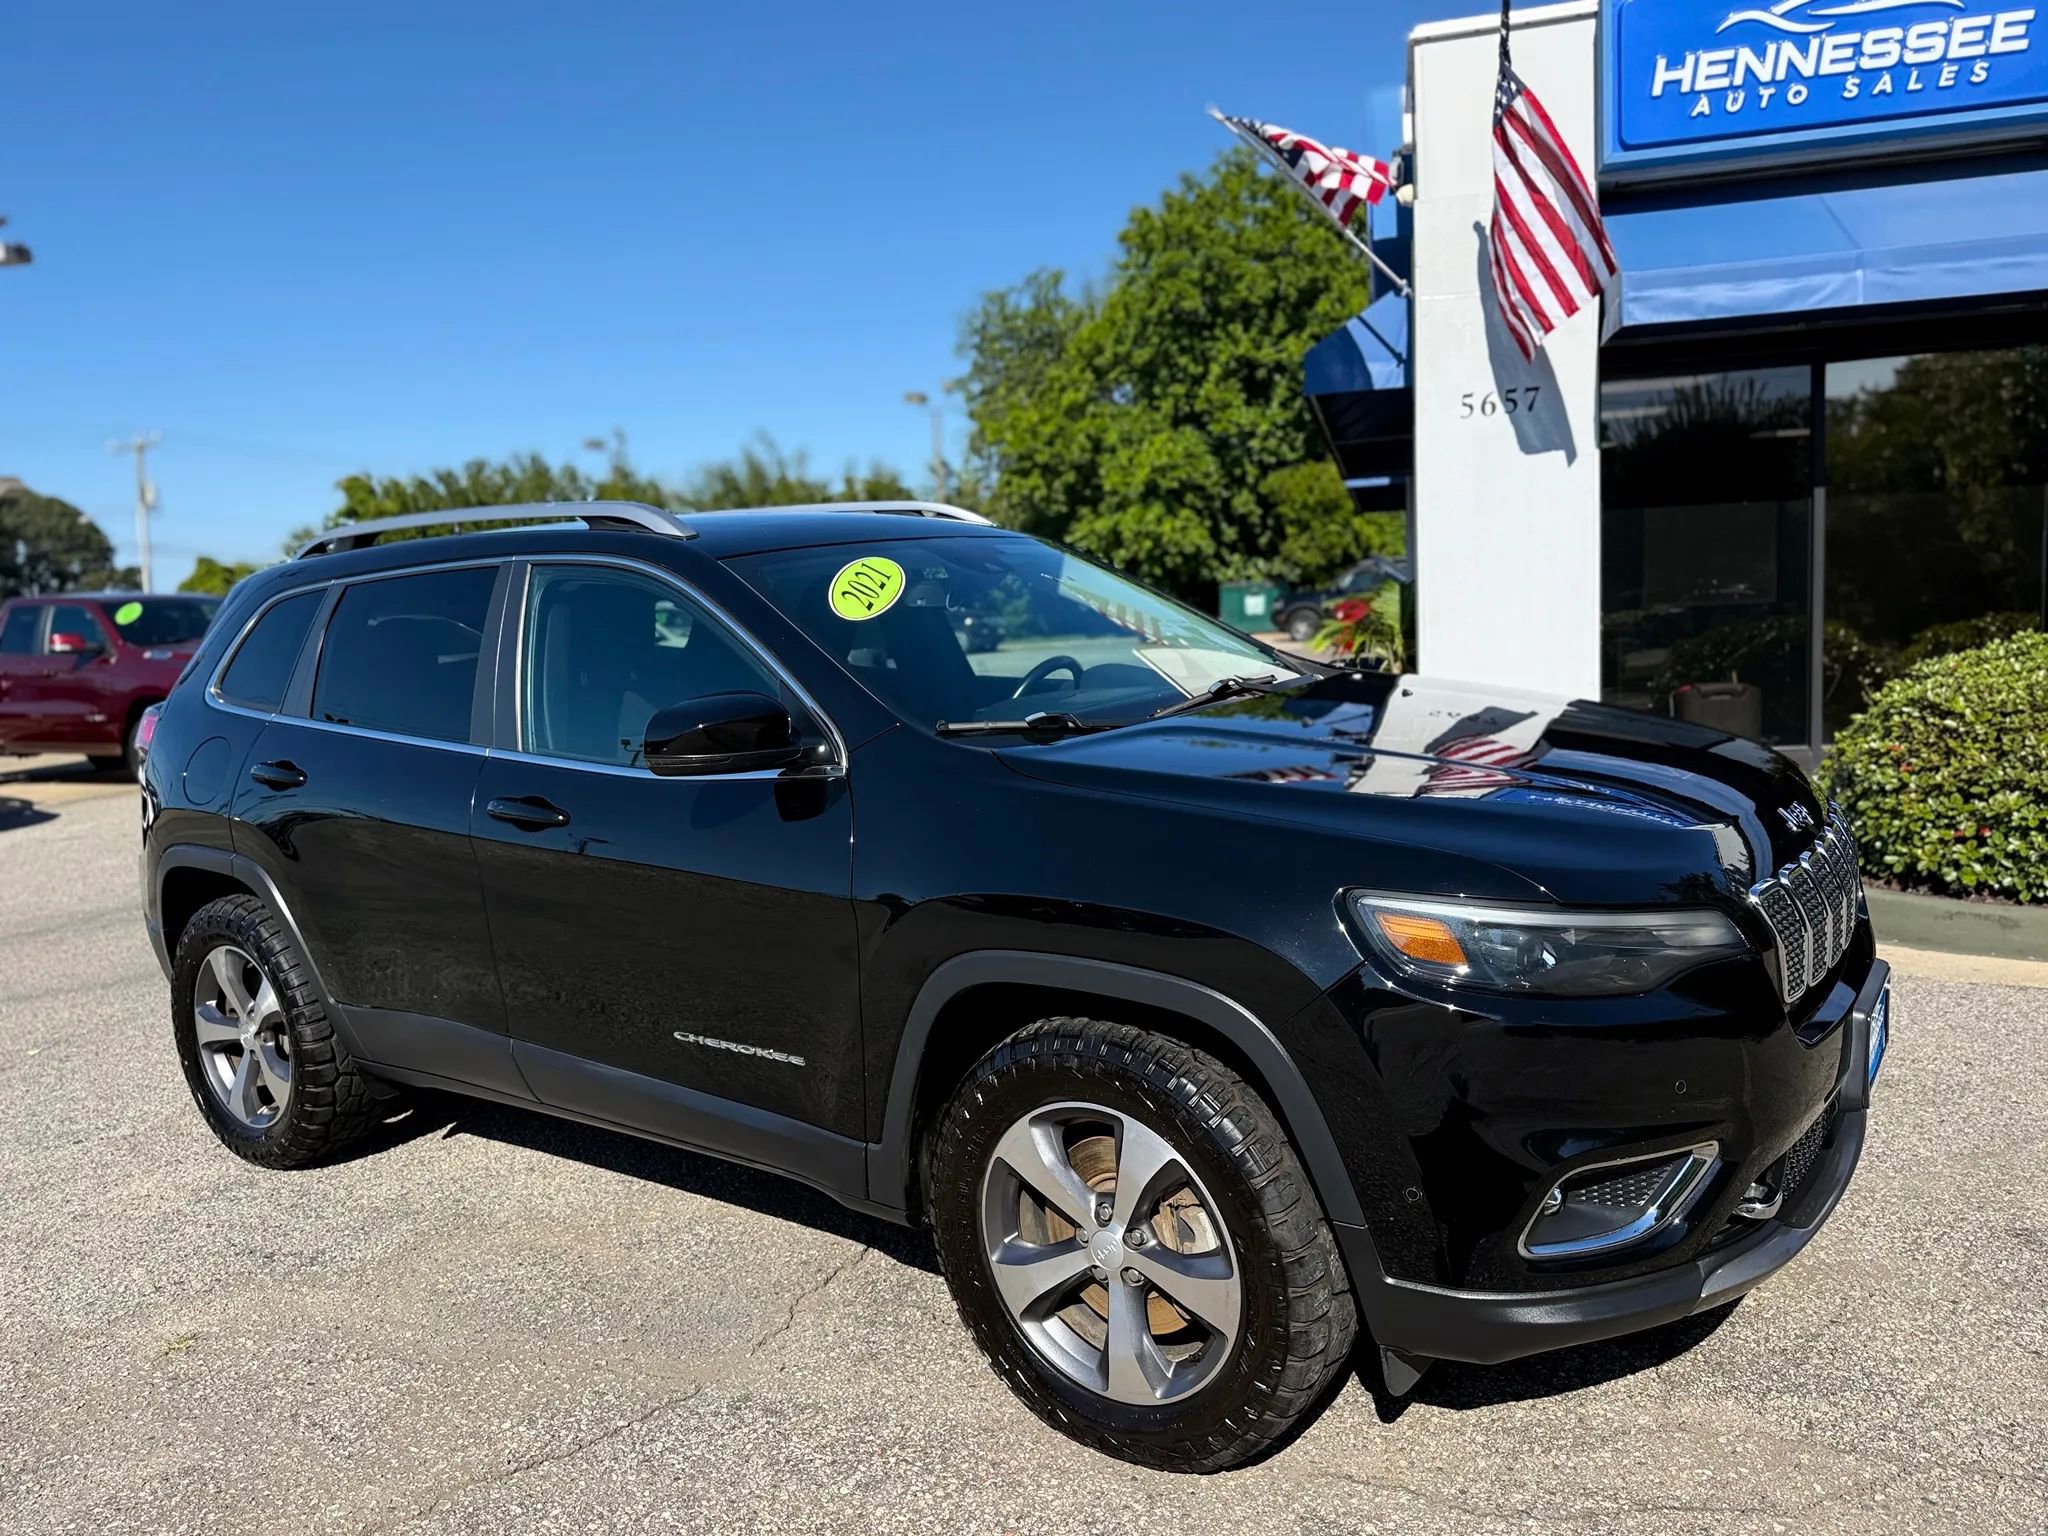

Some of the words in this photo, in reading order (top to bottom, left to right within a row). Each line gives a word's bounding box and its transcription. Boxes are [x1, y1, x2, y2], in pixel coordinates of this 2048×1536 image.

[1651, 9, 2036, 97] HENNESSEE
[1691, 84, 1808, 118] AUTO
[1843, 61, 1990, 99] SALES
[1460, 386, 1541, 419] 5657
[841, 562, 892, 611] 2021
[673, 1031, 806, 1066] CHEROKEE
